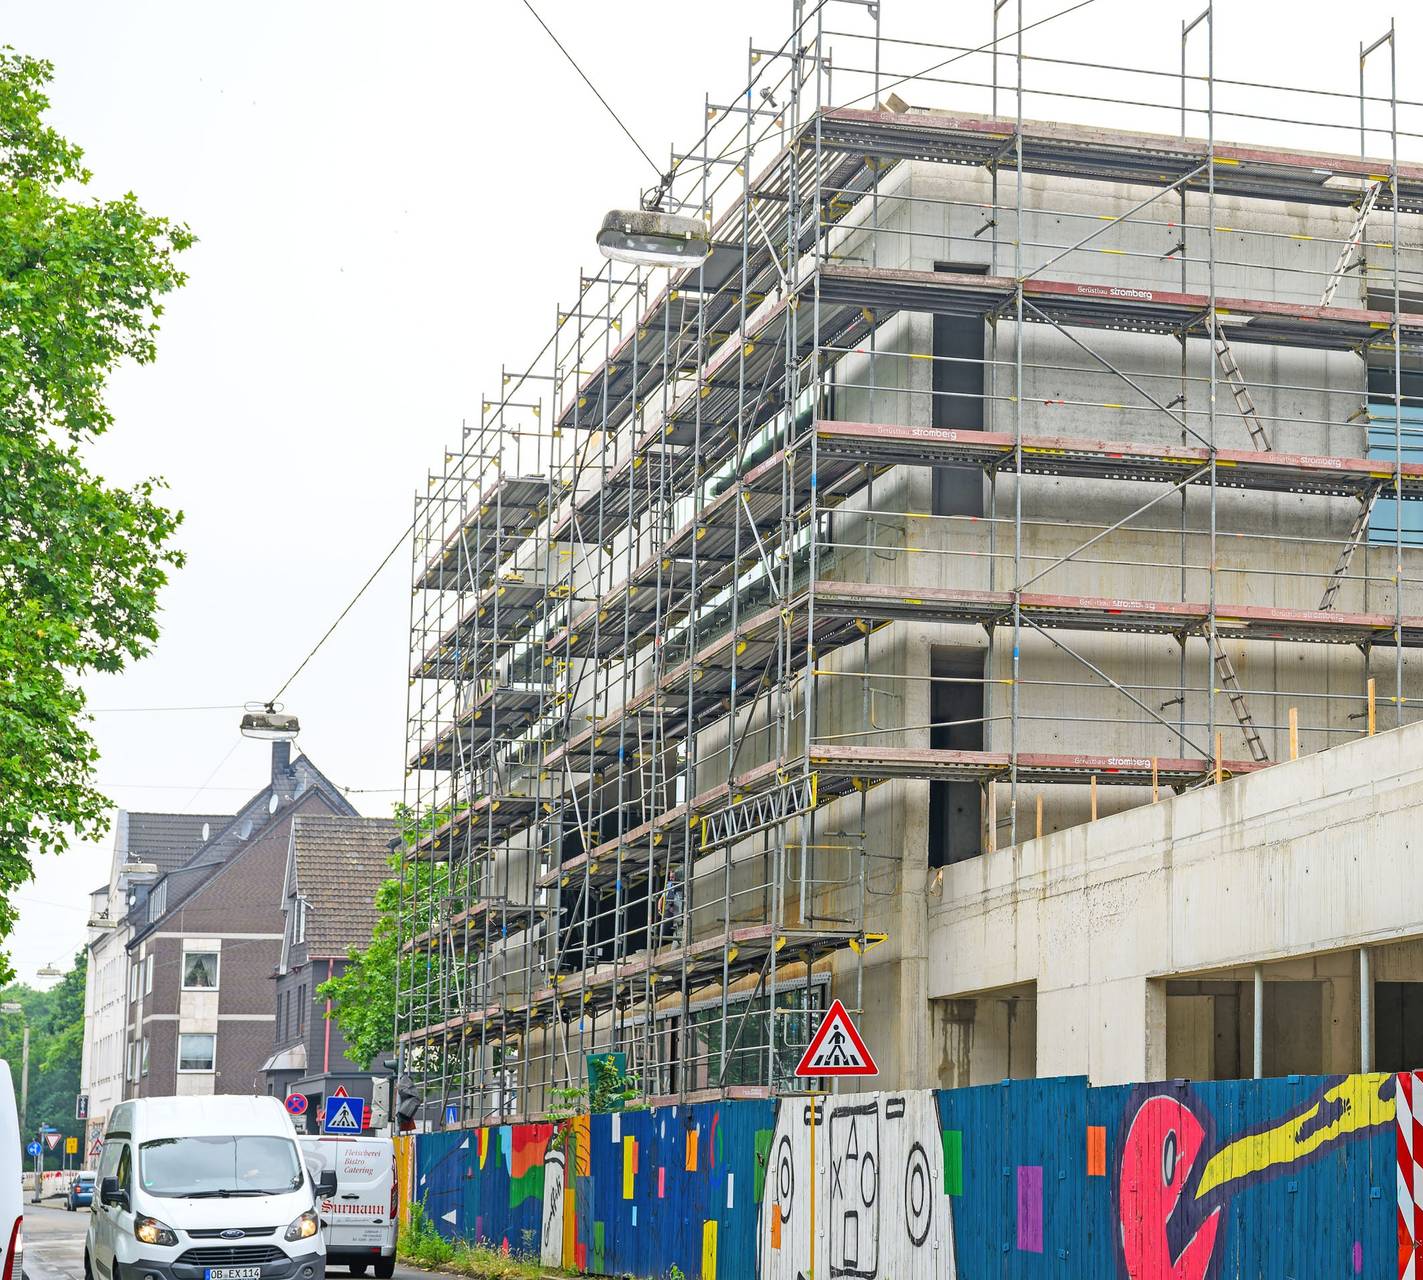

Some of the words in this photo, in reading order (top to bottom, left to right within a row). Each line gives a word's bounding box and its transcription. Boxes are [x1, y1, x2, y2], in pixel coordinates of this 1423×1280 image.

[1109, 287, 1153, 300] stromberg
[911, 427, 957, 441] stromberg
[1300, 455, 1342, 468] stromberg
[1107, 757, 1151, 769] stromberg
[344, 1166, 374, 1176] Catering
[321, 1199, 384, 1214] Surmann
[211, 1270, 223, 1279] OB
[229, 1269, 241, 1279] EX
